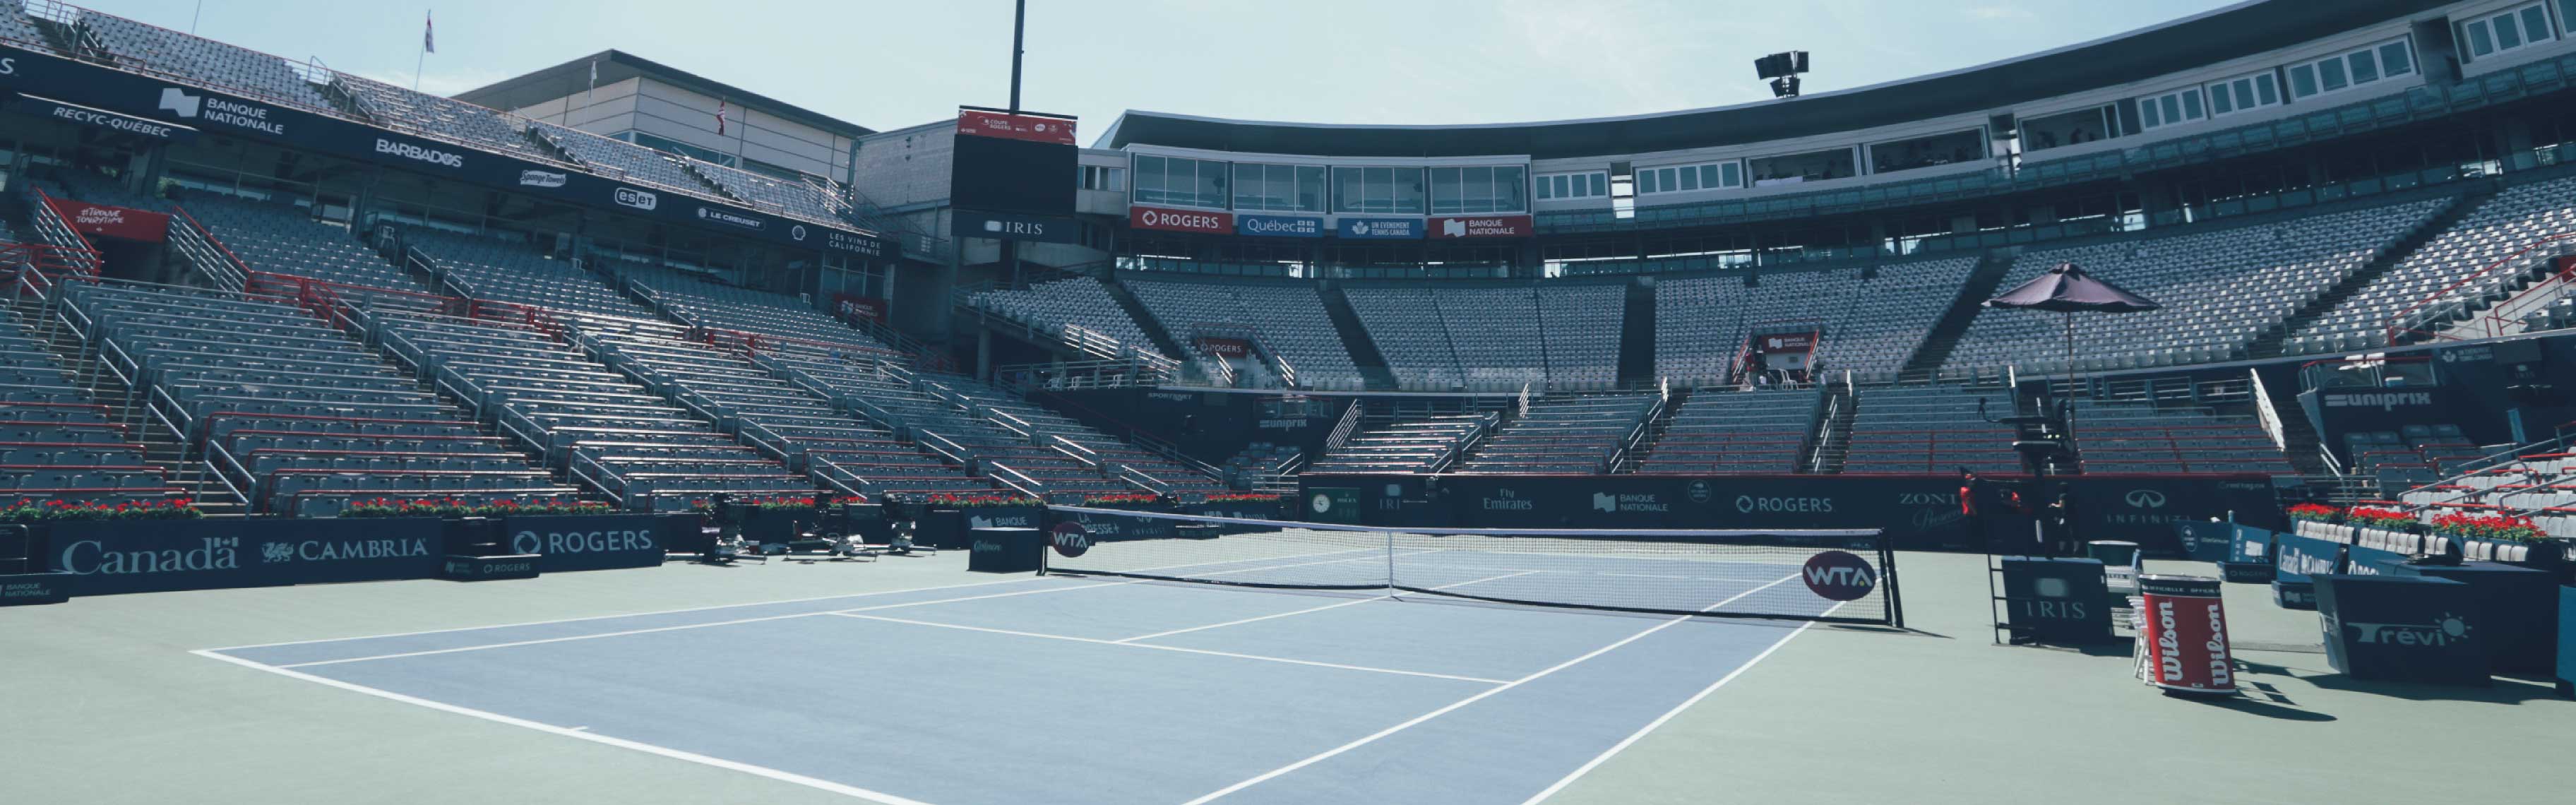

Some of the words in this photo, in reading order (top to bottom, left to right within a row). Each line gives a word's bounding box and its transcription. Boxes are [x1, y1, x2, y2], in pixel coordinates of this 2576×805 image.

[208, 98, 267, 119] BANQUE
[53, 107, 171, 137] RECYC-QUÉBEC
[205, 109, 284, 135] NATIONALE
[376, 139, 463, 167] BARBADOS
[722, 214, 761, 228] CREUSET
[1006, 221, 1043, 235] IRIS
[1162, 213, 1219, 229] ROGERS
[1248, 219, 1296, 233] Québec
[1469, 227, 1515, 235] NATIONALE
[830, 232, 845, 242] LES
[848, 237, 867, 246] VINS
[829, 241, 881, 256] CALIFORNIE
[2347, 391, 2432, 412] uniprix
[1270, 419, 1307, 431] uniprix
[1500, 488, 1515, 499] Fly
[1620, 494, 1655, 503] BANQUE
[1899, 493, 1957, 505] ZONI
[1484, 497, 1532, 511] Emirates
[1620, 503, 1668, 512] NATIONALE
[1758, 497, 1832, 513] ROGERS
[994, 515, 1027, 526] BANQUE
[1078, 513, 1092, 523] LA
[548, 530, 652, 554] ROGERS
[1053, 532, 1087, 549] WTA
[61, 537, 242, 576] Canada
[299, 538, 429, 561] CAMBRIA
[495, 563, 530, 572] ROGERS
[1806, 566, 1872, 587] WTA
[5, 588, 51, 598] NATIONALE
[6, 582, 41, 590] BANQUE
[2027, 601, 2086, 619] IRIS
[2159, 601, 2183, 681] Wilson
[2345, 622, 2445, 645] Trévi
[2207, 603, 2229, 686] Wilson
